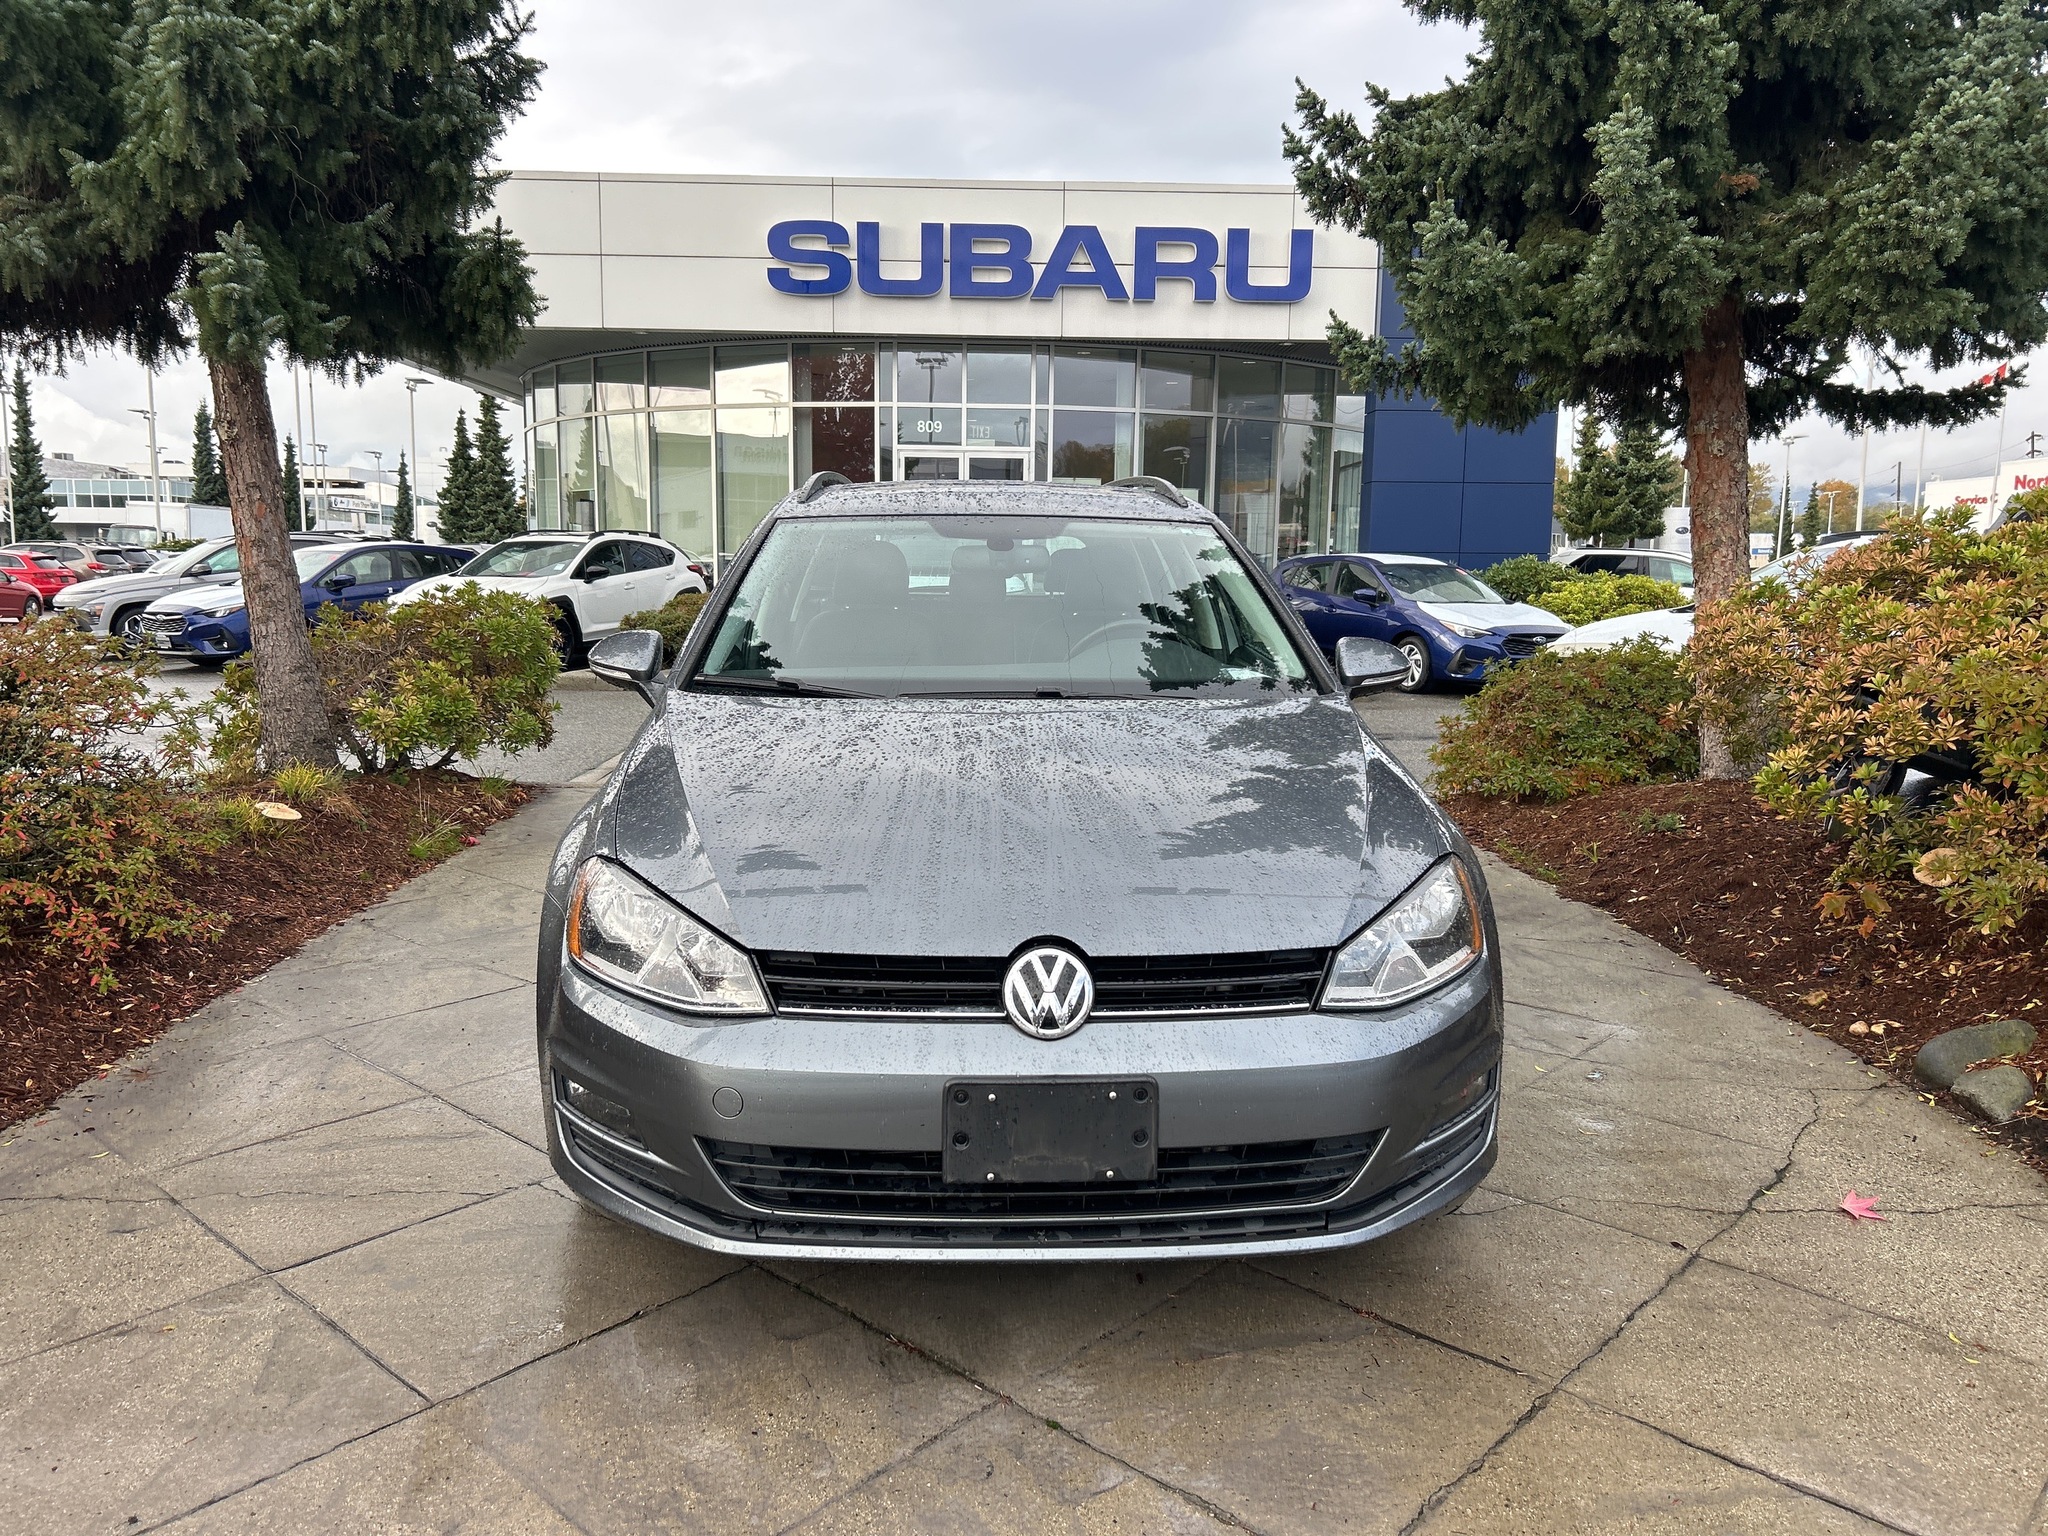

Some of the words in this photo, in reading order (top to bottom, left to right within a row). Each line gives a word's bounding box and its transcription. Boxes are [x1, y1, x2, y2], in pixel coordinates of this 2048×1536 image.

[766, 219, 1315, 303] SUBARU
[917, 420, 943, 433] 809
[1955, 494, 1988, 505] Service
